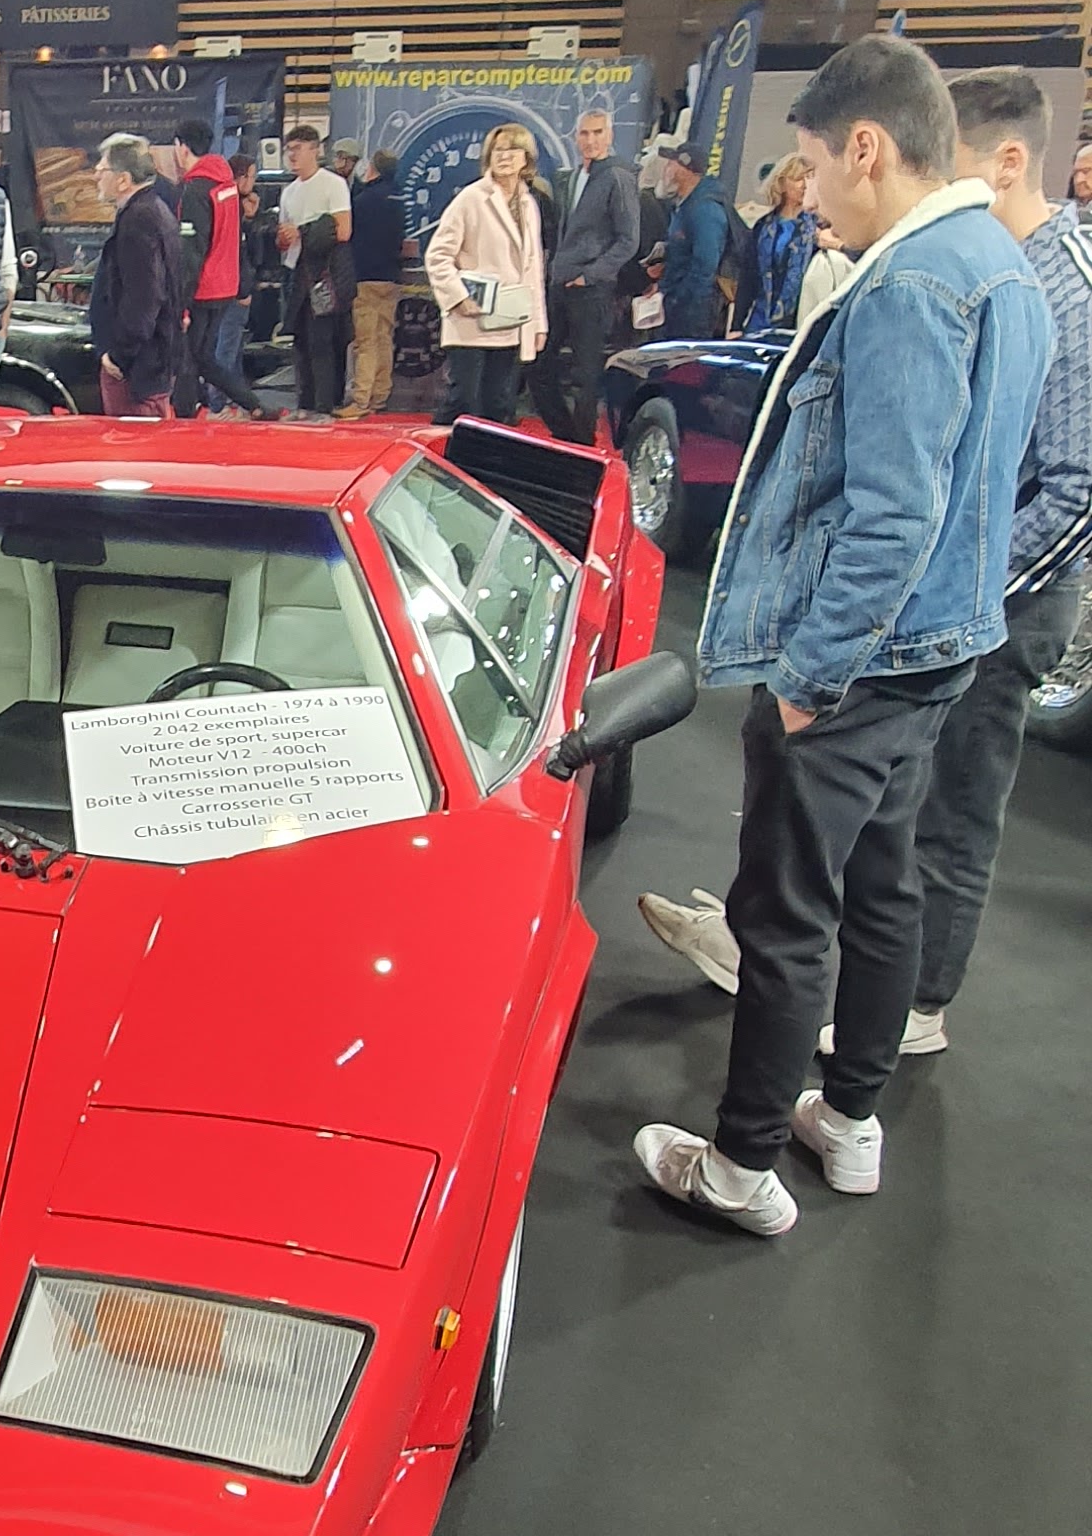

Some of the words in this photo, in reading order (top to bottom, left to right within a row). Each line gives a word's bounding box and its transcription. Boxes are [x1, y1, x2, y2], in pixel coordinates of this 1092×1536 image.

[102, 64, 187, 93] FANO
[335, 64, 632, 91] www.reparcompteur.com
[71, 710, 180, 730] Lamborghini
[185, 703, 267, 719] Countach
[284, 698, 324, 710] 1974
[345, 695, 385, 706] 1990
[152, 726, 163, 737] 2
[167, 723, 200, 735] 042
[204, 714, 310, 731] exemplaires
[120, 740, 185, 755] Voiture
[189, 737, 212, 749] de
[216, 733, 268, 747] sport,
[272, 727, 348, 742] supercar
[148, 754, 214, 769] Moteur
[217, 749, 252, 761] V12
[272, 743, 327, 756] 400ch
[131, 765, 248, 786] Transmission
[253, 758, 351, 776] propulsion
[85, 794, 133, 809] Boîte
[137, 791, 148, 803] à
[152, 785, 214, 801] vitesse
[220, 776, 305, 795] manuelle
[310, 775, 321, 786] 5
[326, 771, 404, 786] rapports
[181, 795, 284, 815] Carrosserie
[288, 792, 313, 805] GT
[134, 820, 203, 839] Châssis
[297, 811, 320, 822] en
[325, 807, 370, 821] acier
